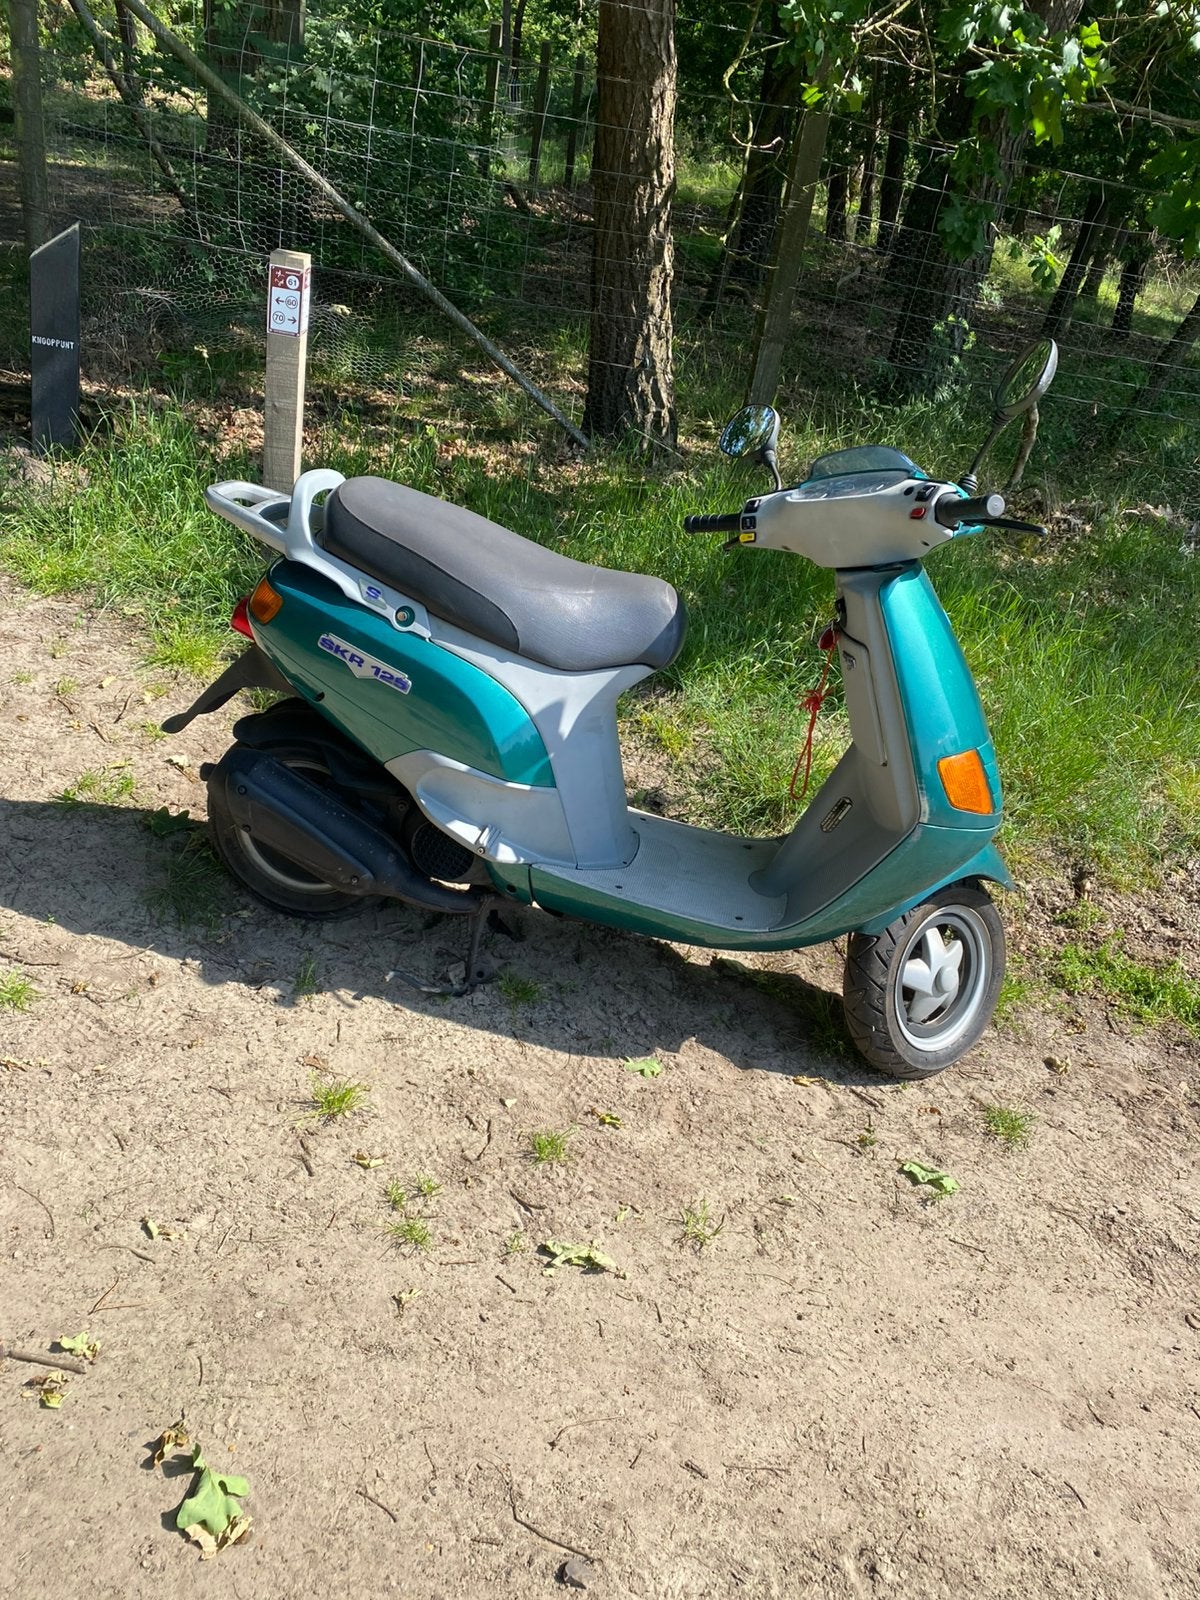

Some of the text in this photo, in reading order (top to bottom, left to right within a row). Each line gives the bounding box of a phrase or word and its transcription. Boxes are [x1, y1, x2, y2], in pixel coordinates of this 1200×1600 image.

[288, 278, 297, 286] 61
[287, 299, 296, 307] 60
[32, 335, 74, 349] KNOOPPUNT
[366, 586, 381, 600] S
[320, 637, 408, 691] SKR 125
